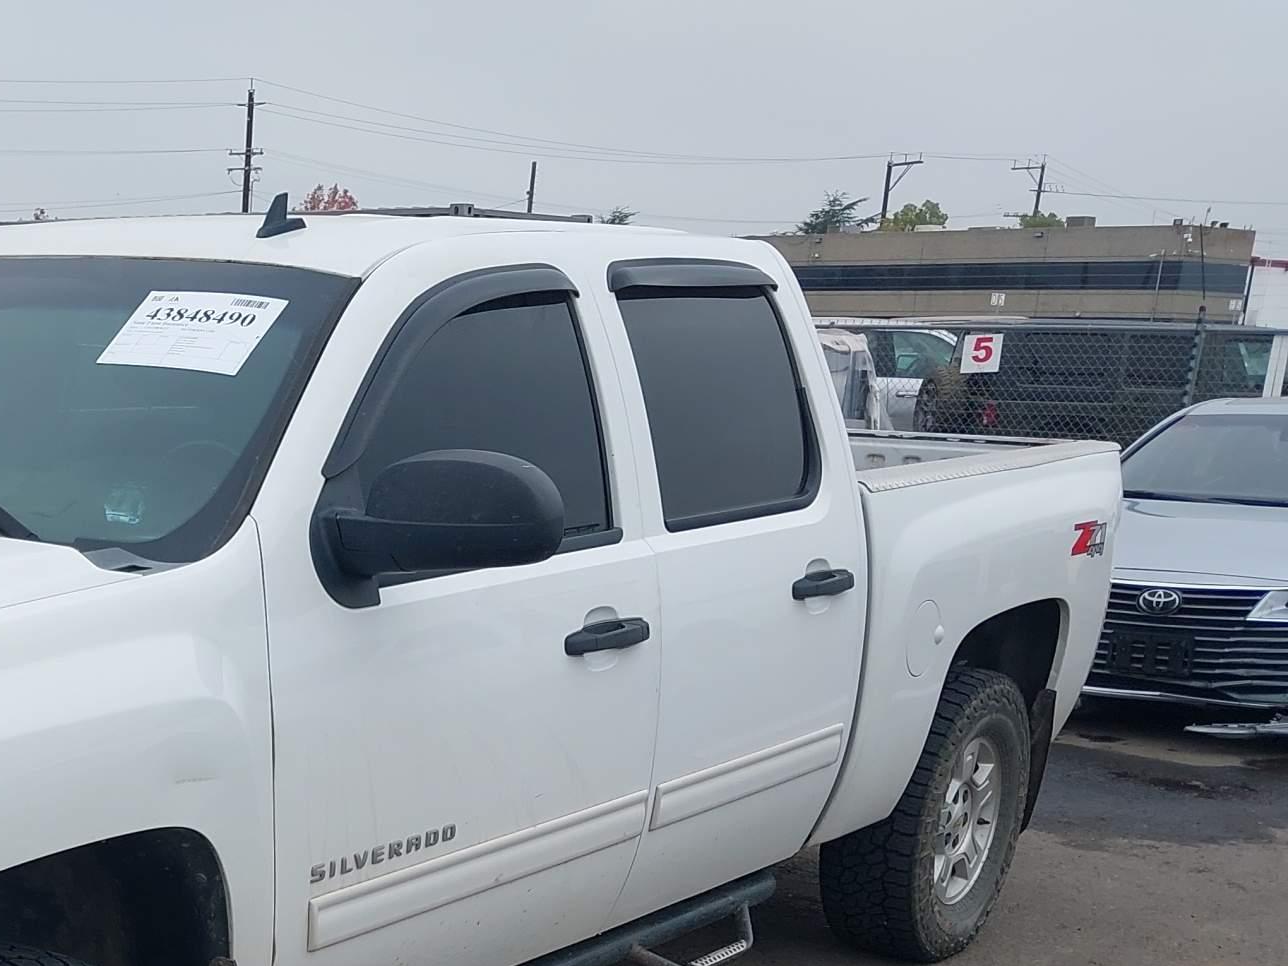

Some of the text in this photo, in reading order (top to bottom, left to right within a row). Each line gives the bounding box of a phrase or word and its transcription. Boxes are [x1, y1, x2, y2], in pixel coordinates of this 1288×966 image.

[145, 306, 257, 327] 43848490
[972, 336, 994, 363] 5
[1071, 520, 1107, 556] Z71
[309, 823, 457, 884] SILVERADO
